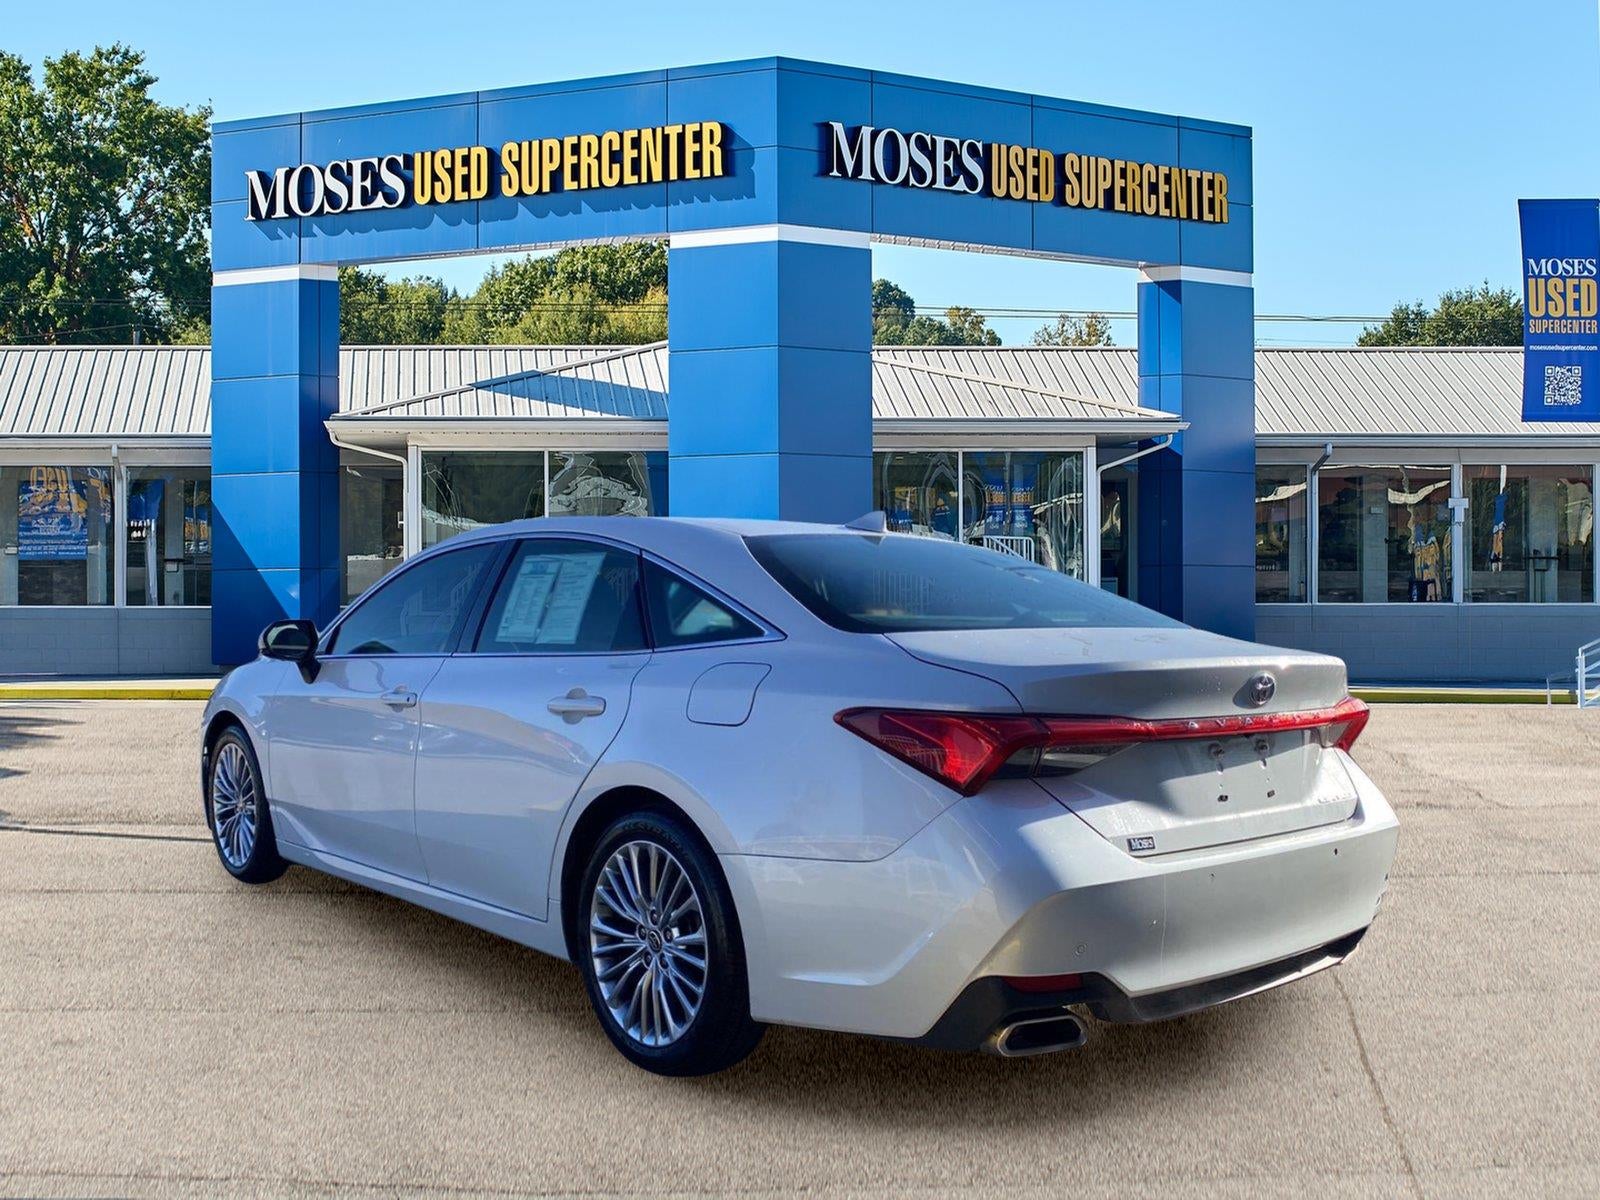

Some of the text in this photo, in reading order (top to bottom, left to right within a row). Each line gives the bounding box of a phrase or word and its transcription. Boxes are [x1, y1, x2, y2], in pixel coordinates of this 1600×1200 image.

[244, 121, 724, 221] MOSES USED SUPERCENTER
[829, 121, 1229, 224] MOSES USED SUPERCENTER
[1527, 258, 1597, 276] MOSES
[1528, 277, 1598, 318] USED
[1529, 319, 1598, 334] SUPERCENTER
[1188, 714, 1320, 730] AVA
